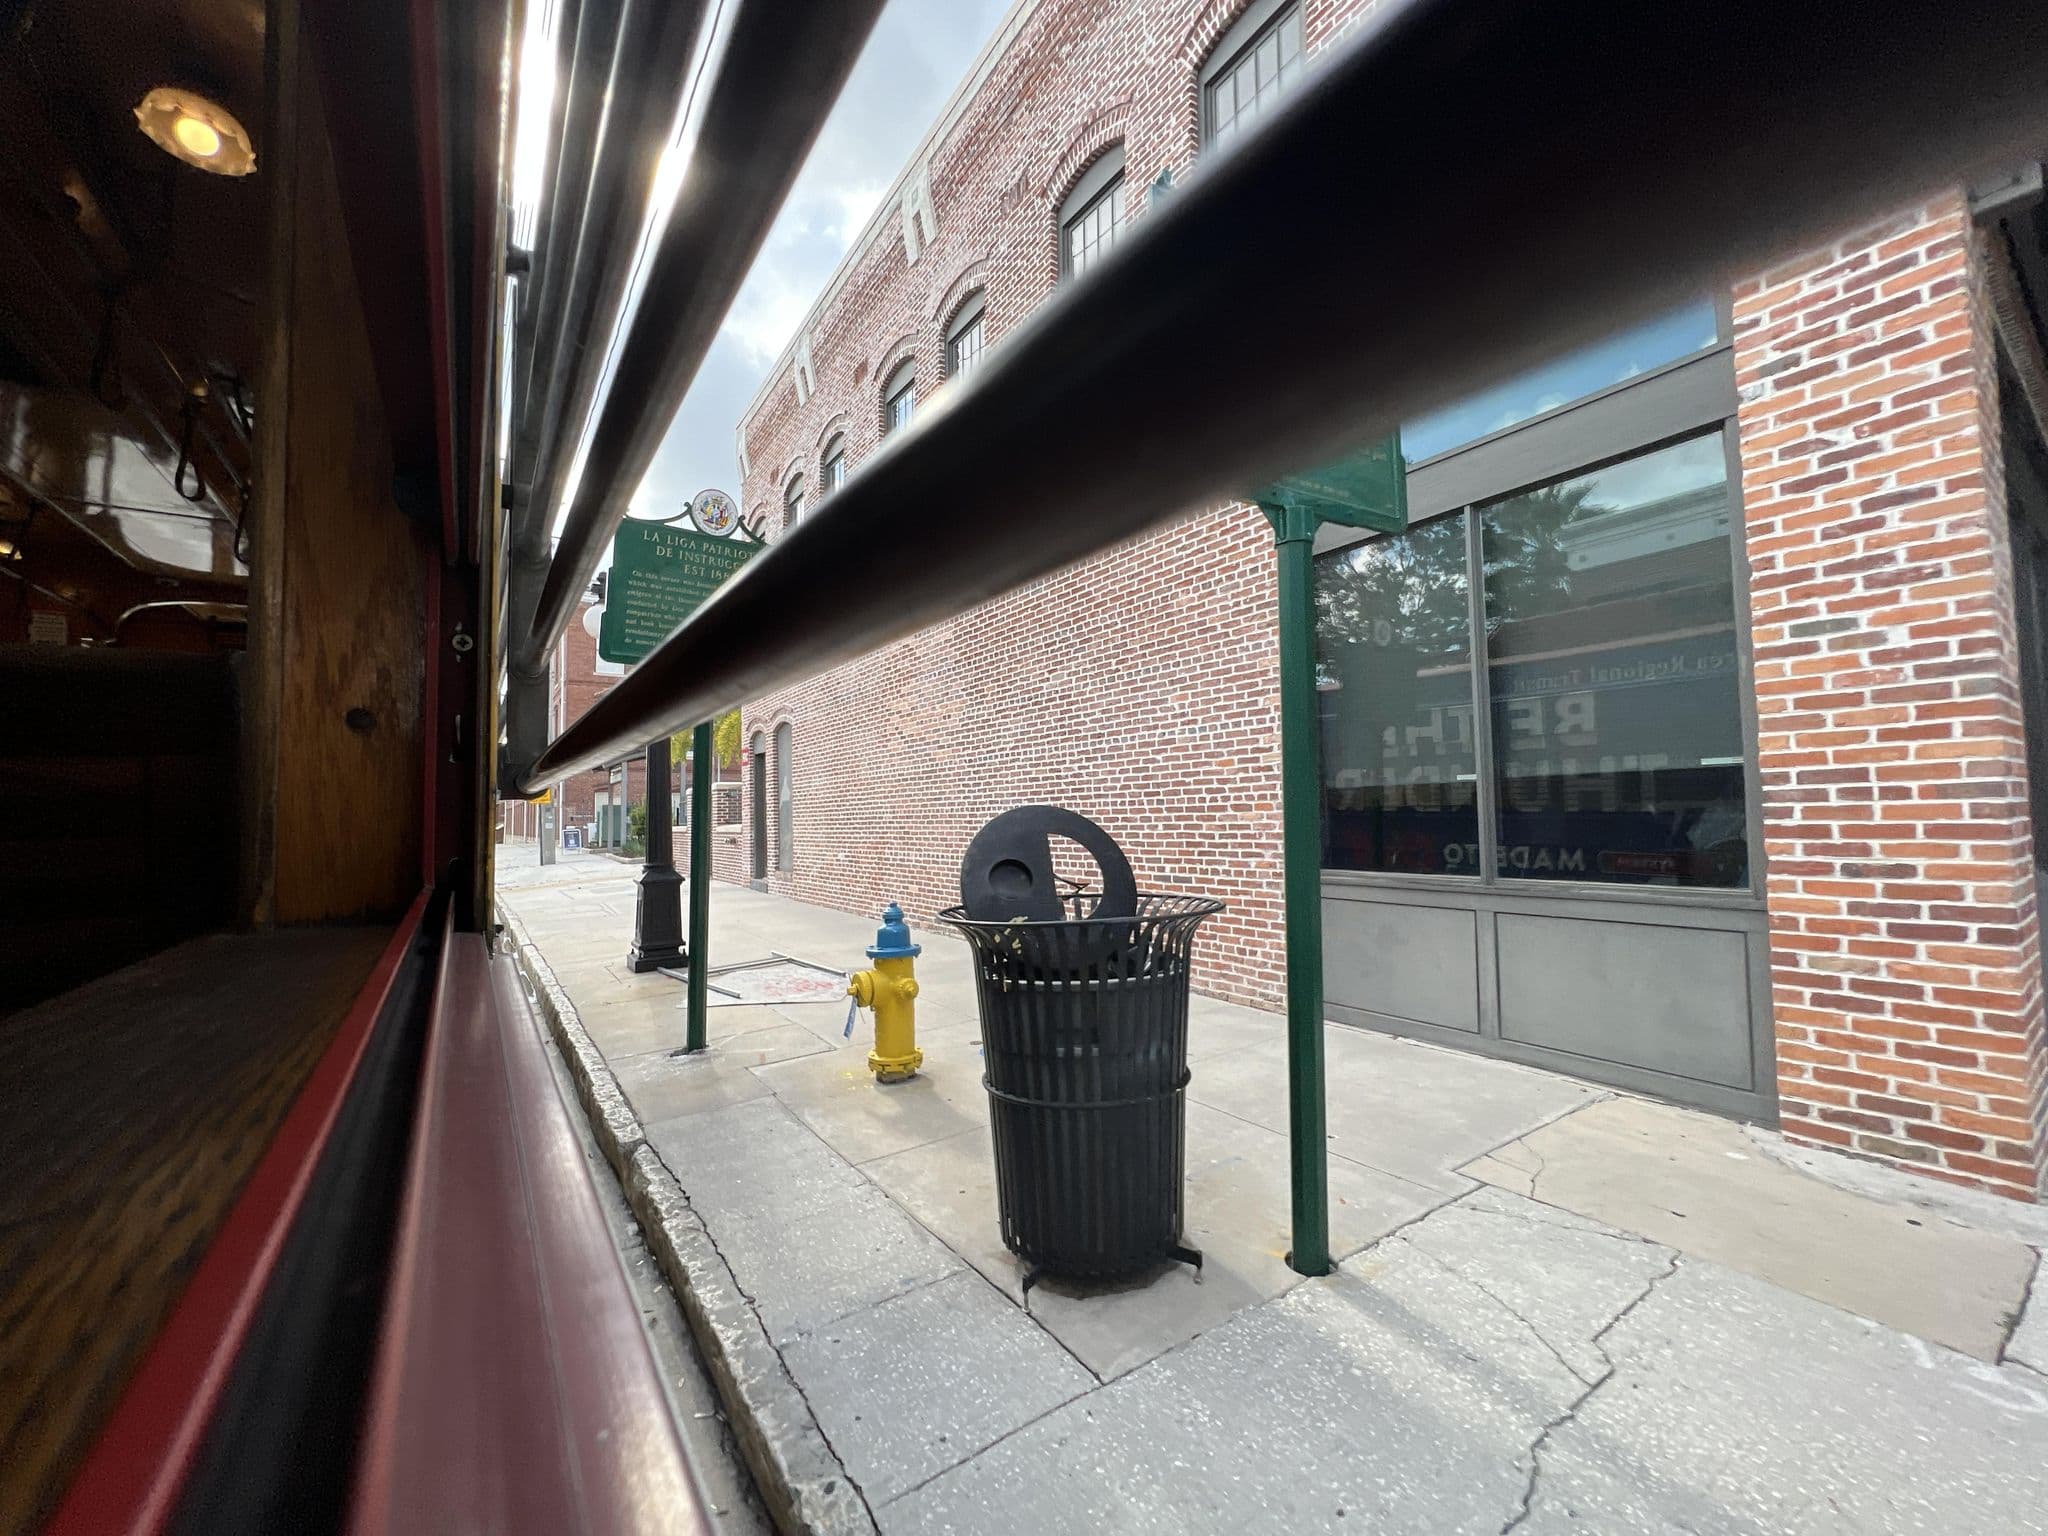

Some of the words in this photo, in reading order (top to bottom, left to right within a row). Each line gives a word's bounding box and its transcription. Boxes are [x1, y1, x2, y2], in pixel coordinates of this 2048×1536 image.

[643, 529, 660, 543] LA
[667, 535, 697, 550] LIGA
[702, 542, 756, 560] PATRIOT
[656, 547, 673, 558] DE
[679, 551, 743, 571] INSTRUCC
[684, 565, 705, 577] EST
[711, 569, 730, 581] 188
